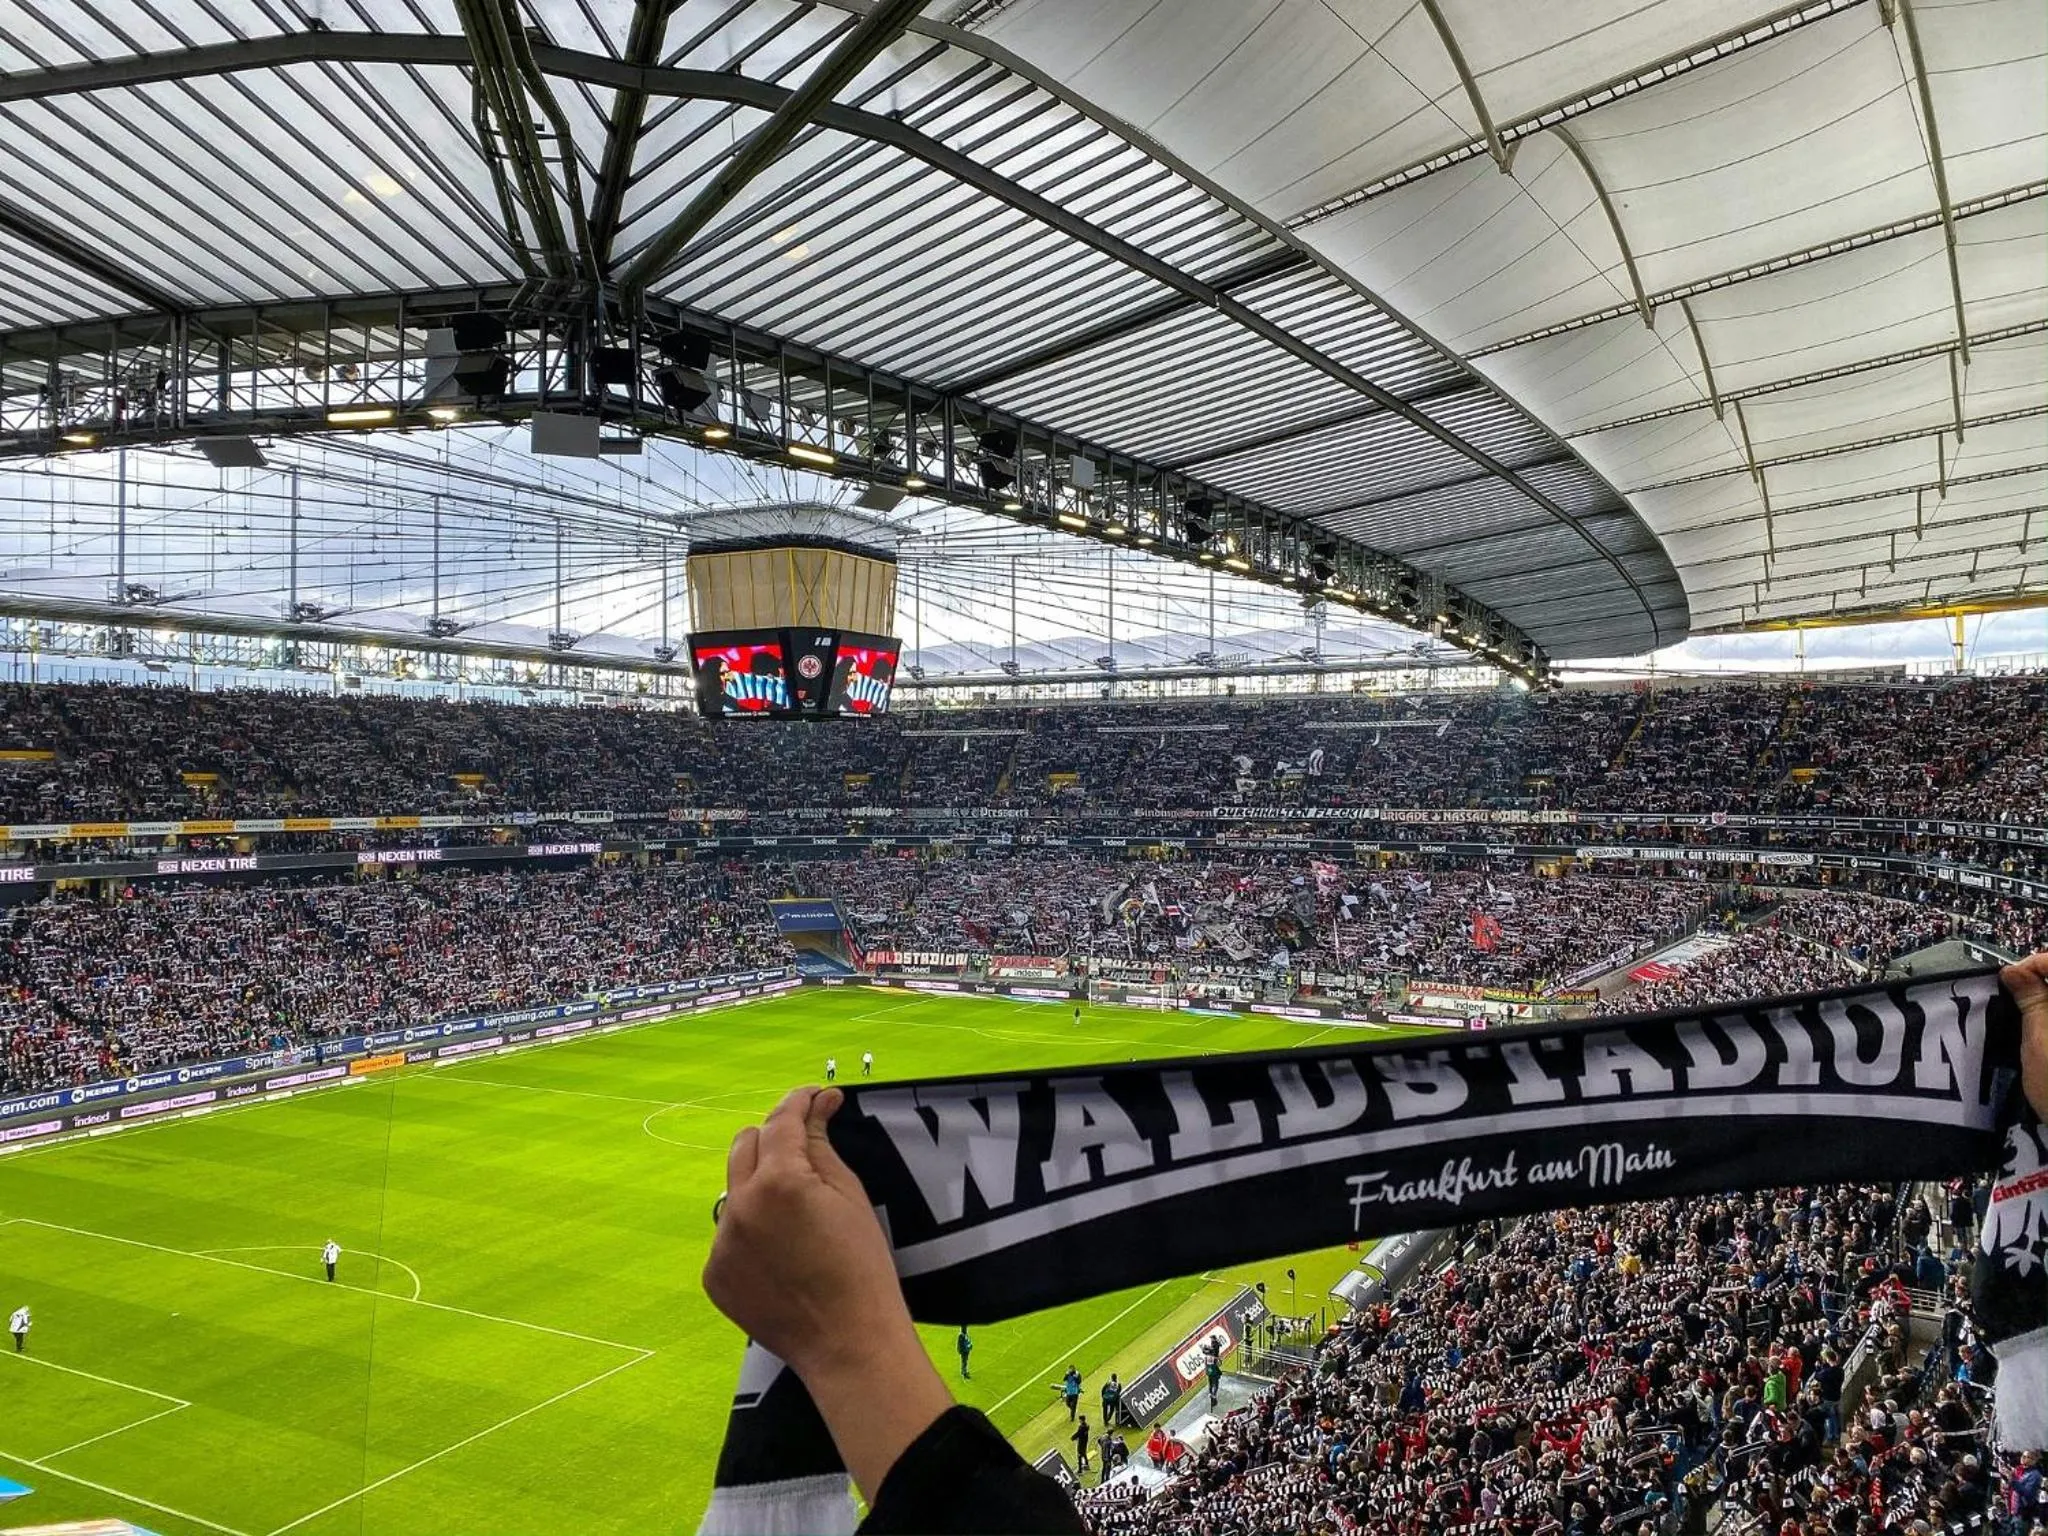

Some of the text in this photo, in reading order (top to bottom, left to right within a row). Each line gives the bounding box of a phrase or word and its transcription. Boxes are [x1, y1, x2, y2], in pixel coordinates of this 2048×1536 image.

[1380, 810, 1430, 822] BRIGADE
[1443, 810, 1488, 822] NASSAU
[377, 851, 415, 863] NEXEN
[416, 849, 442, 861] TIRE
[545, 844, 578, 856] NEXEN
[580, 843, 602, 853] TIRE
[181, 859, 226, 872] NEXEN
[226, 858, 258, 870] TIRE
[0, 867, 35, 881] TIRE
[866, 951, 969, 966] WALDSTADION
[902, 964, 931, 975] indeed
[1326, 986, 1357, 999] indeed
[1454, 1000, 1487, 1013] indeed
[225, 1084, 257, 1098] indeed
[73, 1111, 110, 1128] indeed
[1345, 1142, 1677, 1232] Frankfurt am Main
[1131, 1379, 1171, 1418] indeed
